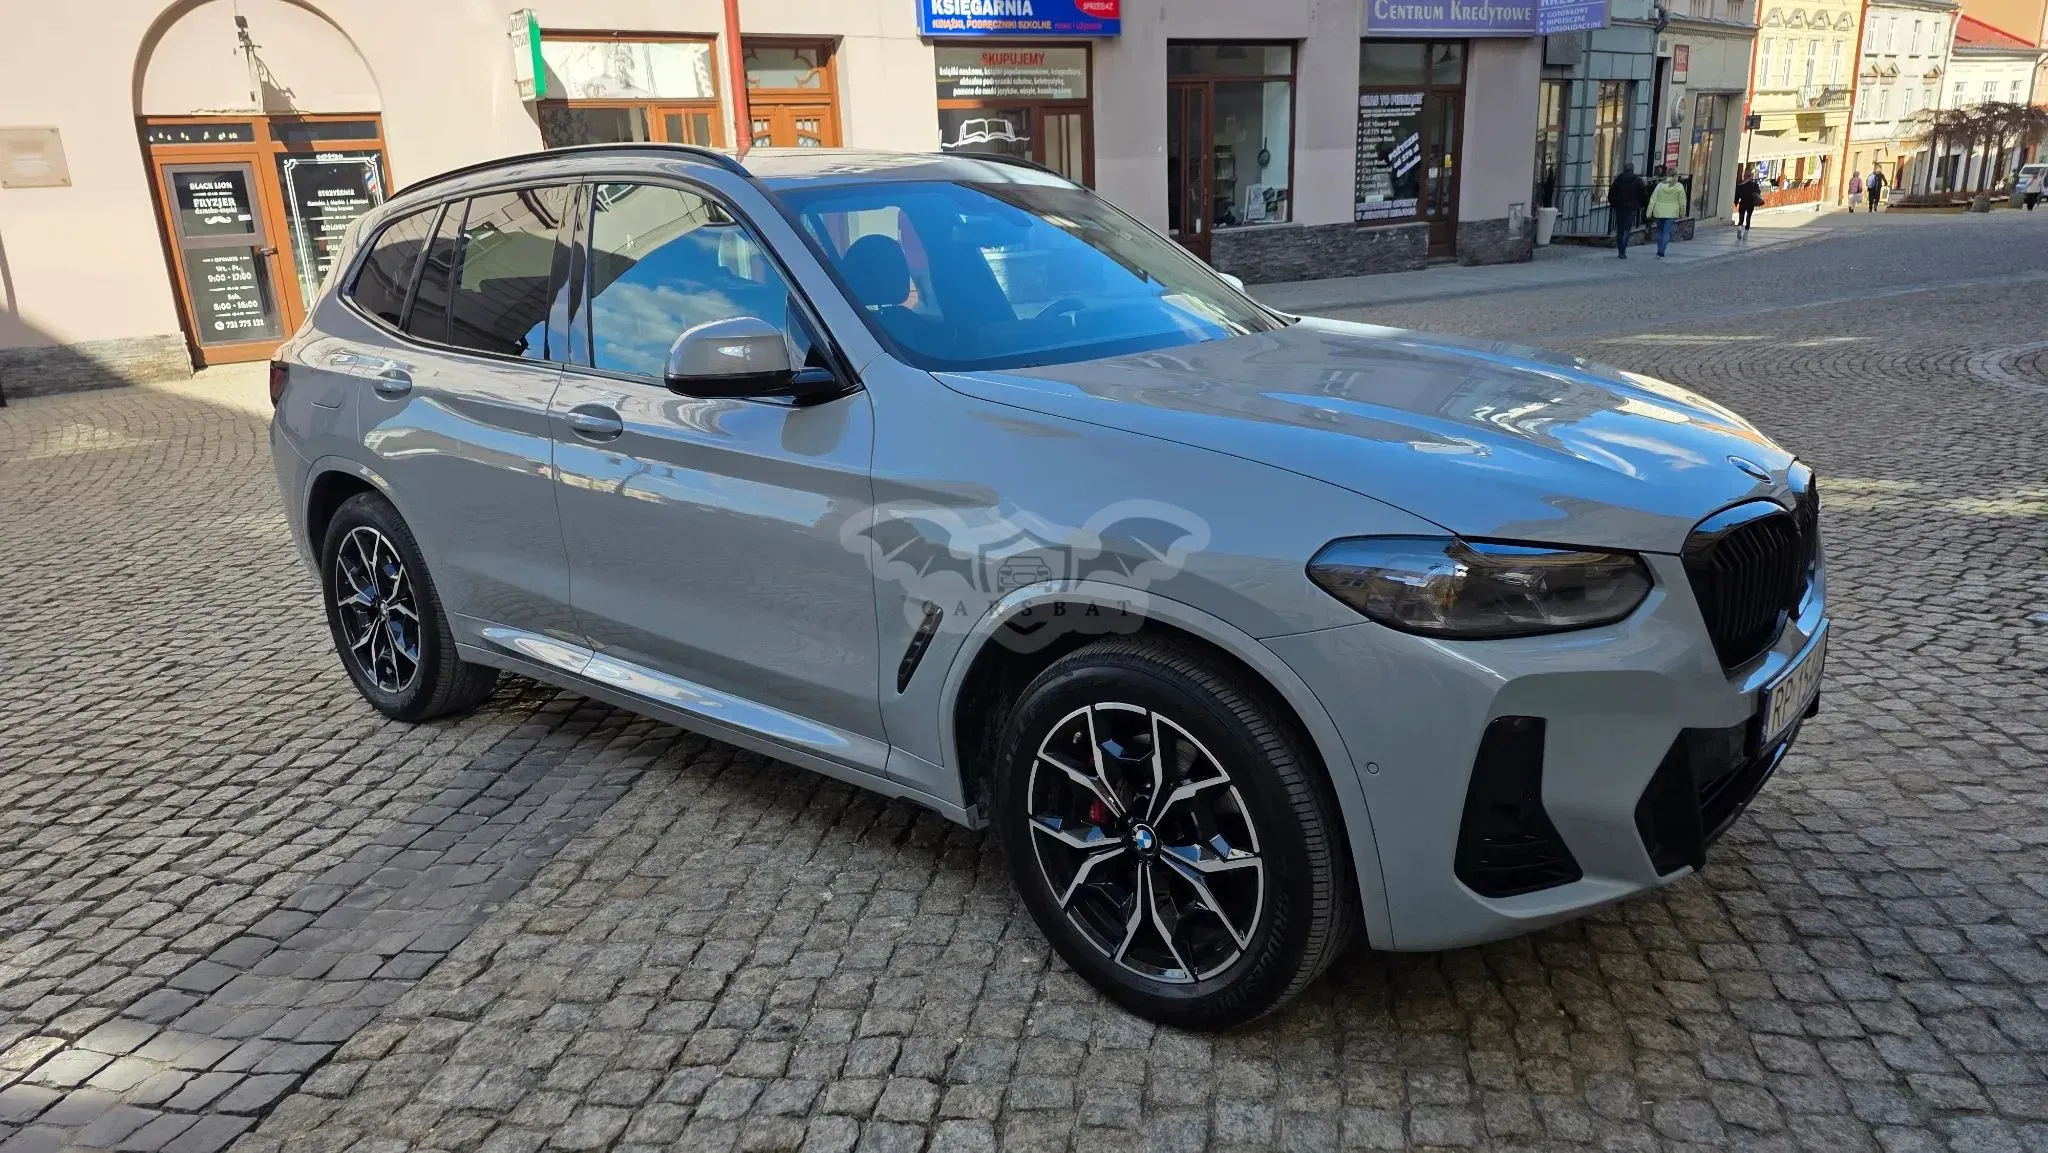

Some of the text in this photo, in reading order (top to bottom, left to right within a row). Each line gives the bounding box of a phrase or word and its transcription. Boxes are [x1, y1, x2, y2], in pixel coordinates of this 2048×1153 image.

[932, 0, 1034, 18] KSIĘGARNIA
[1018, 20, 1051, 29] SZKOLNE
[982, 52, 1045, 65] SKUPUJEMY
[189, 181, 233, 191] BLACK LION
[192, 197, 237, 208] FRYZJER
[208, 273, 226, 282] 9:00
[232, 271, 252, 281] 17:00
[225, 321, 238, 329] 721
[1771, 677, 1794, 734] RP
